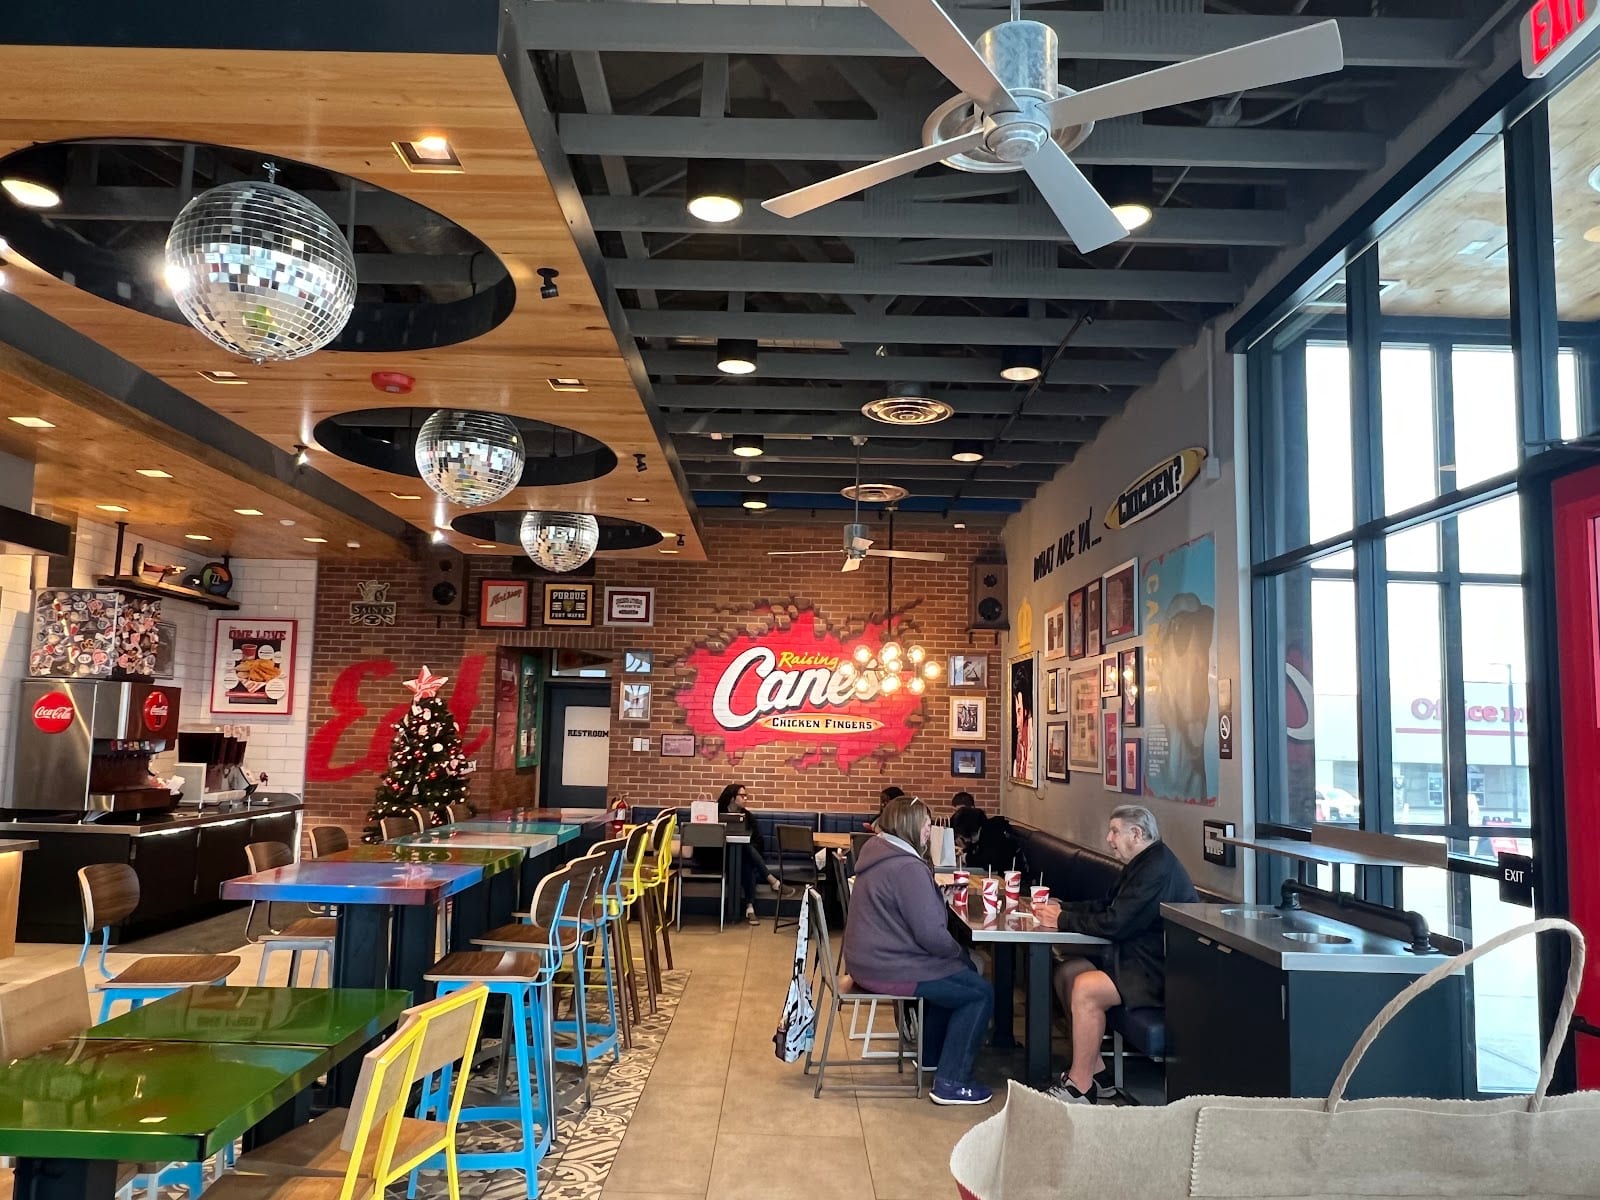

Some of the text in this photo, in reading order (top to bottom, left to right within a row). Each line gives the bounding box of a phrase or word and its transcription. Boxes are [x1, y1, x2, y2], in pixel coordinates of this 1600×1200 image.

[1118, 455, 1183, 525] CHICKEN?
[1033, 544, 1055, 582] WHAT
[1056, 529, 1075, 567] ARE
[552, 591, 586, 600] PURDUE
[352, 604, 394, 615] SAINTS
[229, 629, 287, 640] ONE LOVE
[778, 651, 840, 669] Raising
[34, 705, 73, 720] Coca-Cola
[772, 717, 872, 730] CHICKEN FINGERS
[567, 729, 609, 738] RESTROOM
[1504, 868, 1525, 884] EXIT
